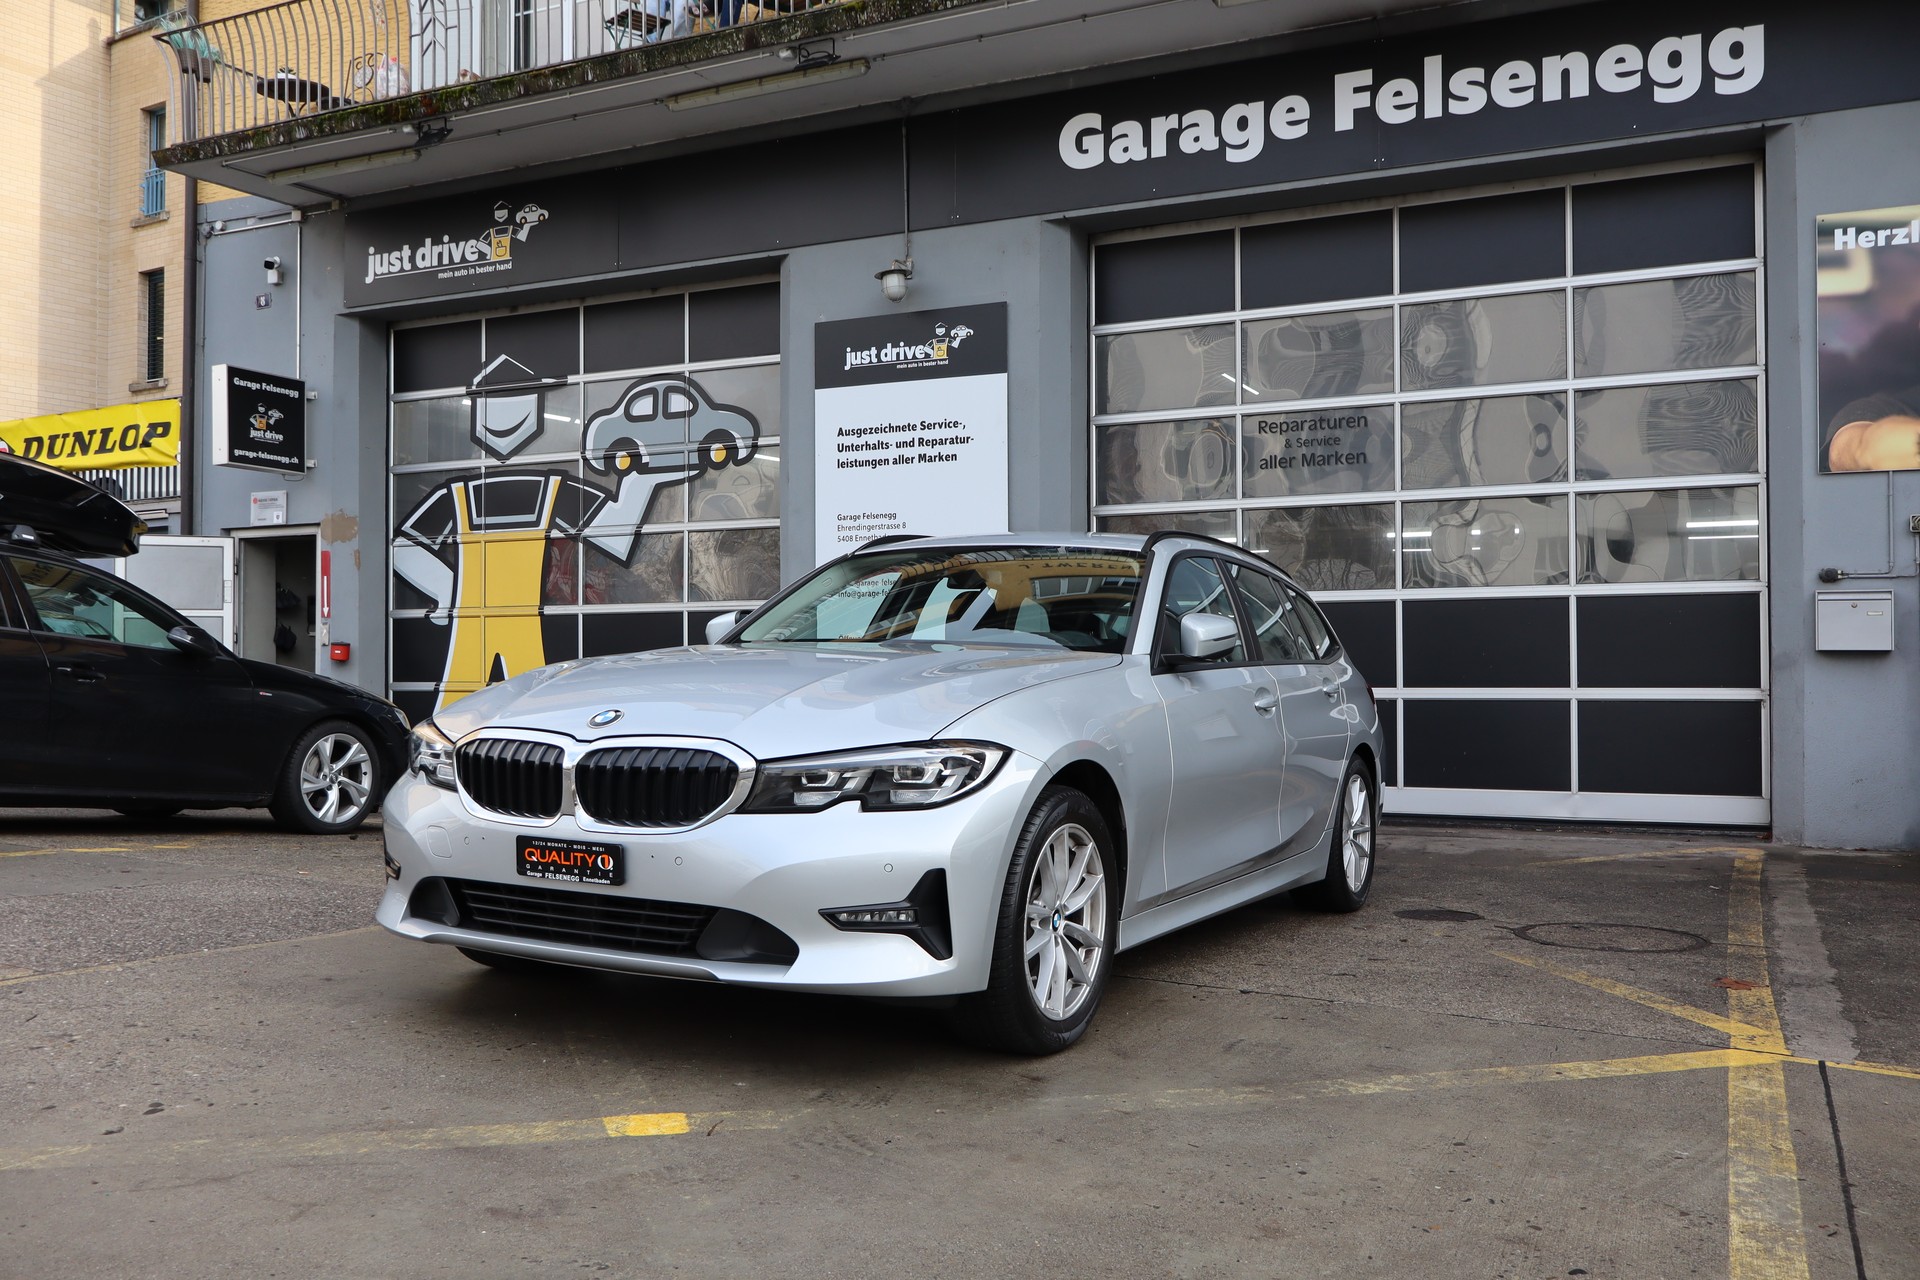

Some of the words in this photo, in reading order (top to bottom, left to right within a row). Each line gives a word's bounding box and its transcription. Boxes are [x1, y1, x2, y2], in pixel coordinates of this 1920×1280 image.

[1059, 95, 1310, 170] Garage
[1334, 24, 1765, 132] Felsenegg
[1834, 220, 1920, 251] Herzl
[365, 245, 412, 284] just
[415, 234, 479, 268] drive
[437, 270, 453, 279] mein
[454, 269, 467, 277] auto
[468, 267, 475, 275] in
[475, 266, 495, 275] bester
[496, 262, 512, 271] hand
[844, 347, 878, 370] just
[880, 341, 925, 362] drive
[233, 377, 261, 390] Garage
[262, 382, 299, 399] Felsenegg
[249, 427, 264, 438] just
[264, 430, 284, 441] drive
[837, 422, 917, 438] Ausgezeichnete
[920, 418, 966, 431] Service-,
[1258, 416, 1368, 435] Reparaturen
[22, 421, 172, 460] DUNLOP
[837, 439, 893, 453] Unterhalts-
[895, 437, 915, 449] und
[918, 435, 974, 449] Reparatur-
[1284, 438, 1292, 448] &
[1296, 436, 1341, 448] Service
[234, 449, 299, 464] garage-felsenegg.ch
[837, 457, 890, 469] leistungen
[892, 454, 915, 465] aller
[918, 451, 958, 464] Marken
[1259, 454, 1296, 470] aller
[1301, 451, 1367, 467] Marken
[837, 513, 861, 522] Garage
[862, 512, 897, 520] Felsenegg
[837, 522, 901, 532] Ehrendingerstrasse
[902, 521, 907, 529] 8
[837, 535, 854, 543] 5408
[525, 848, 596, 867] QUALITY
[526, 870, 543, 878] Garage
[544, 872, 580, 882] FELSENEGG
[582, 876, 611, 884] Ennetbaden
